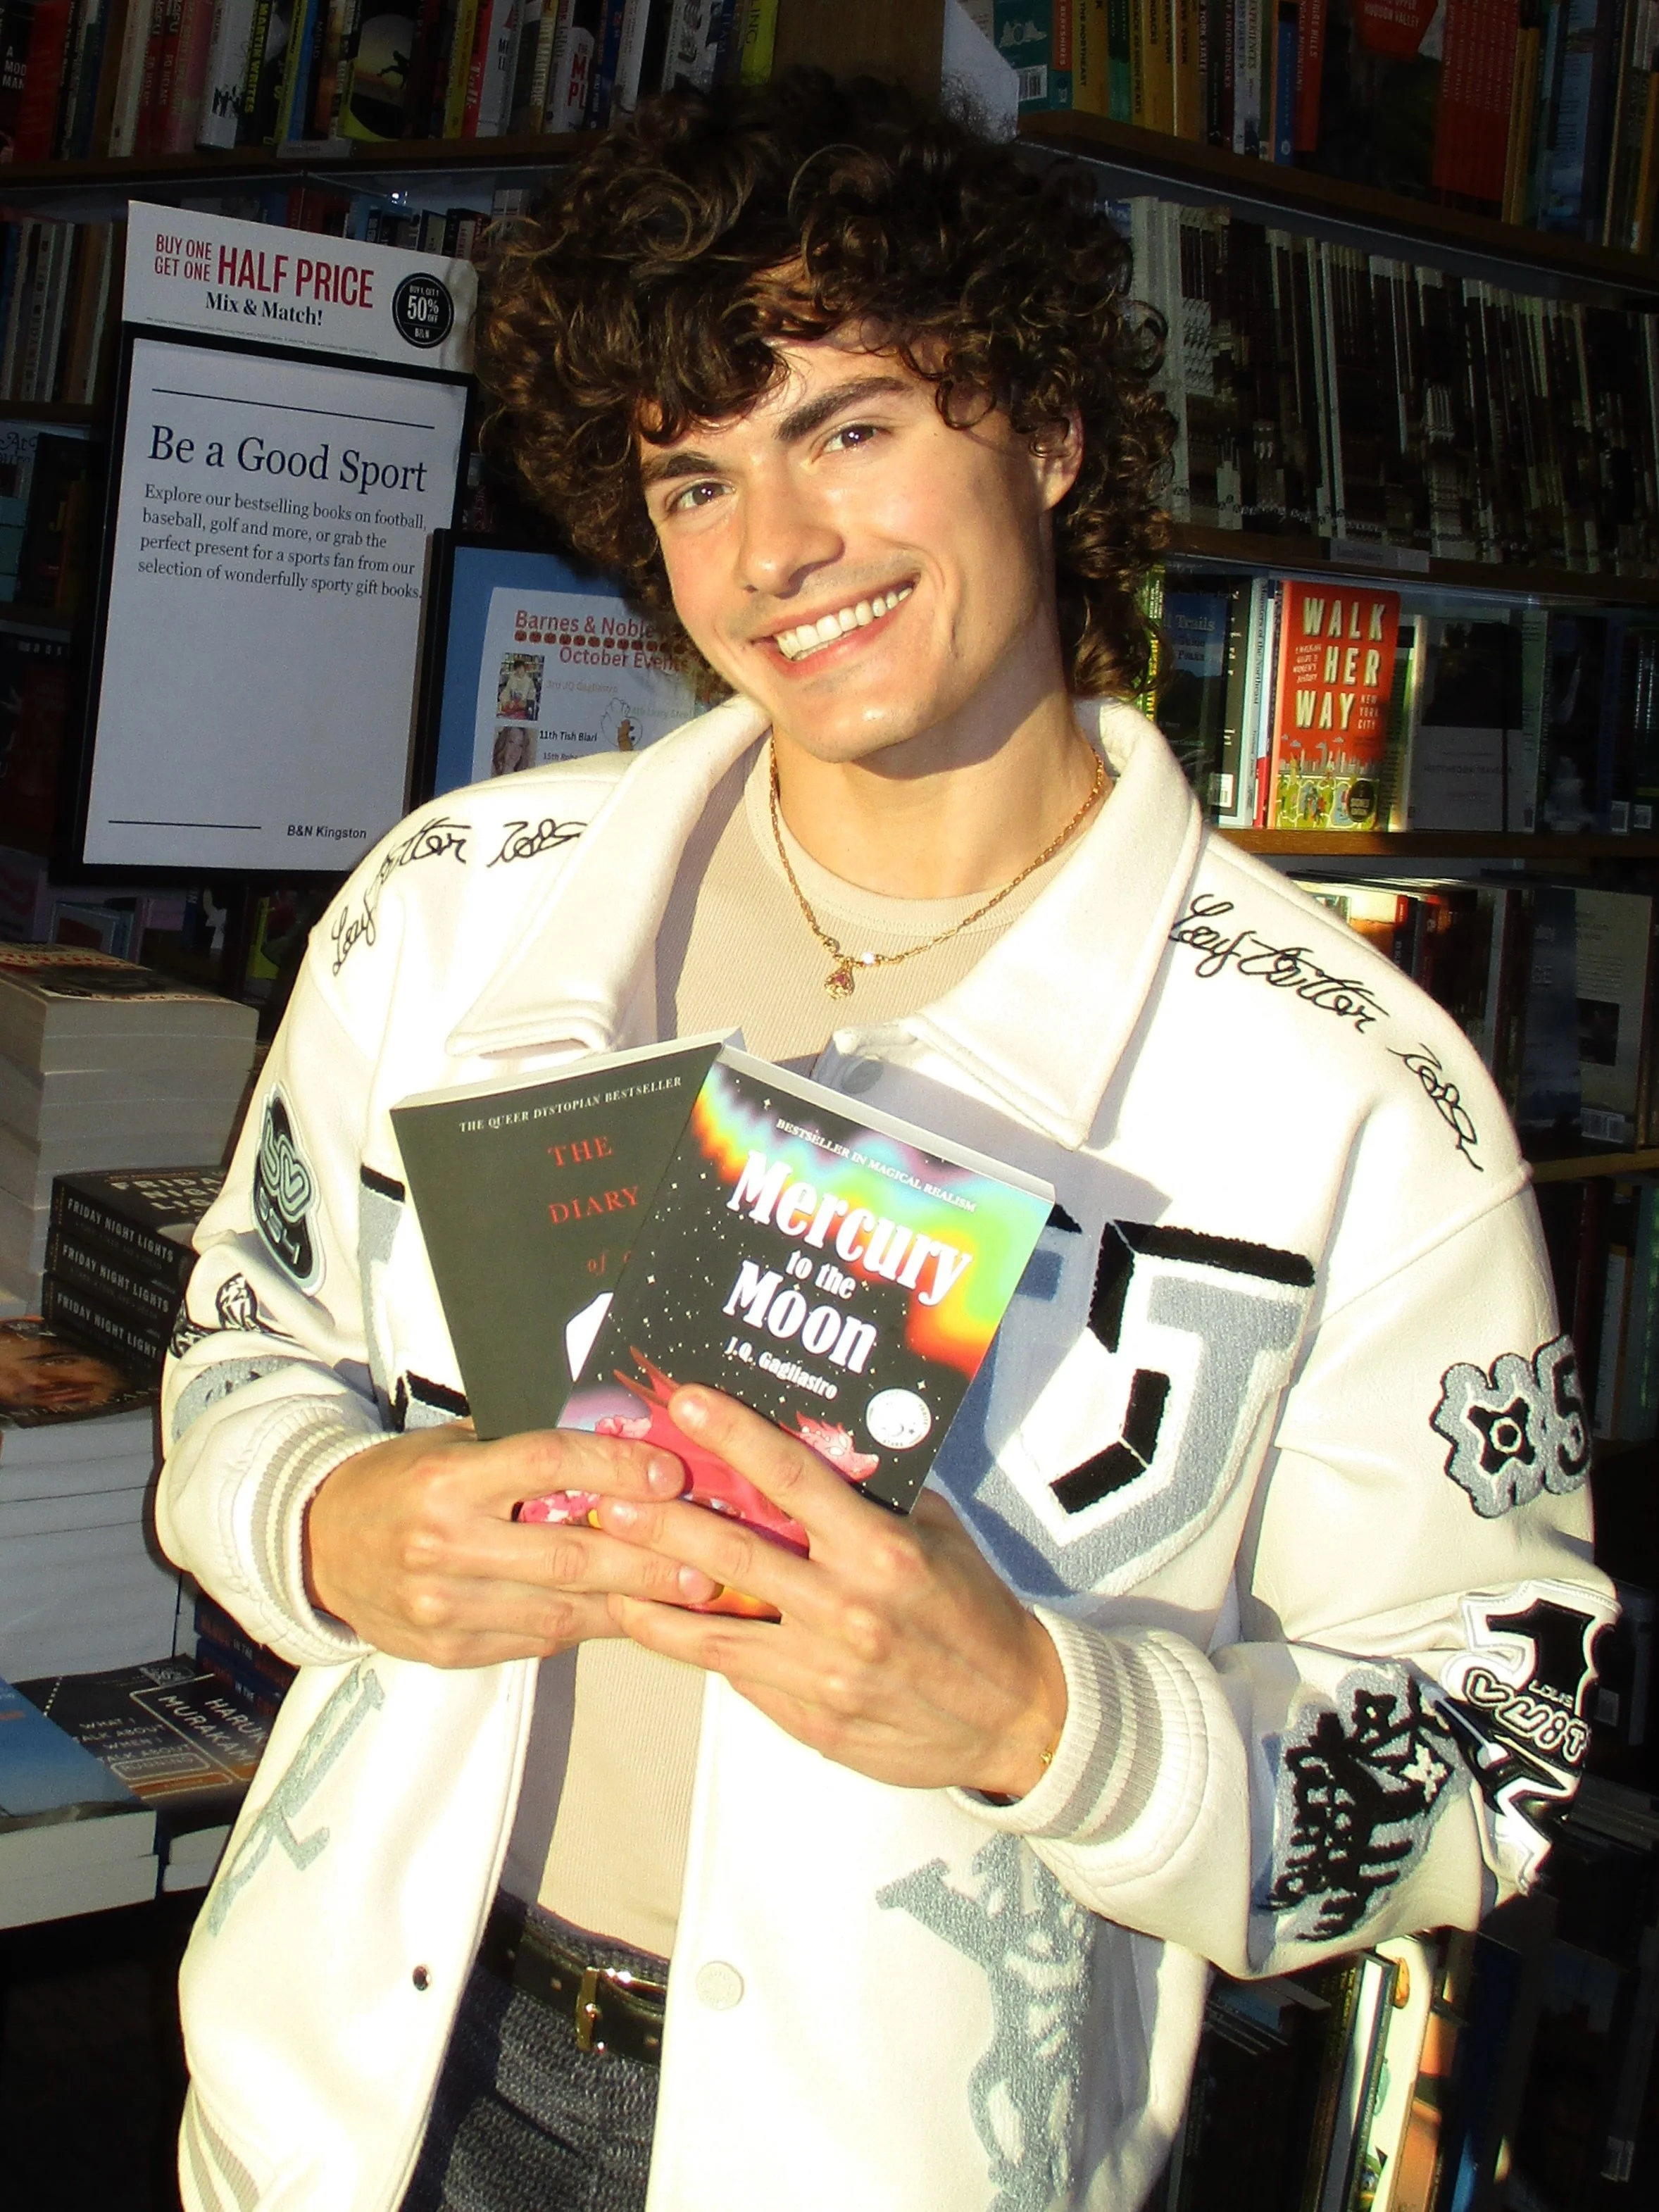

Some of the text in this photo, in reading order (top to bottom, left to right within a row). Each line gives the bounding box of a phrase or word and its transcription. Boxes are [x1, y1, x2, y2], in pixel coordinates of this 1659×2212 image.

[244, 1, 269, 116] MARTIN WRITES
[156, 234, 212, 261] BUY ONE
[154, 256, 211, 282] GET ONE
[218, 245, 374, 308] HALF PRICE
[206, 291, 323, 325] Mix & Match!
[407, 294, 439, 322] 50%
[148, 424, 428, 495] Be a Good Sport
[145, 484, 427, 531] Explore our bestselling books on football,
[142, 507, 387, 549] baseball, golf and more, or grab the
[140, 534, 415, 575] perfect present for a sports fan from our
[138, 559, 422, 599] selection of wonderfully sporty gift books.
[515, 610, 653, 638] Barnes & Noble
[1303, 596, 1386, 642] WALK
[560, 646, 628, 667] October
[1323, 646, 1381, 687] HER
[1253, 658, 1263, 704] Northeast
[1360, 694, 1377, 704] NEW
[1296, 689, 1355, 730] WAY
[1358, 719, 1375, 730] CITY
[1359, 706, 1378, 718] YORK
[539, 730, 557, 740] 11th
[560, 731, 576, 741] Tish
[287, 824, 367, 840] B&N Kingston
[459, 1076, 682, 1133] THE QUEER DYSTOPIAN BESTSELLER
[548, 1135, 613, 1168] THE
[776, 1118, 977, 1213] BESTSELLER IN MAGICAL REALISM
[111, 1177, 223, 1191] FRIDA
[141, 1187, 220, 1199] NIG
[150, 1199, 213, 1211] LIG
[549, 1185, 639, 1224] DIARY
[68, 1198, 102, 1225] FRIDAY
[105, 1216, 134, 1242] NIGHT
[137, 1233, 174, 1263] LIGHTS
[726, 1149, 972, 1307] Mercury
[62, 1244, 97, 1273] FRIDAY
[99, 1265, 130, 1290] NIGHT
[132, 1283, 170, 1313] LIGHTS
[587, 1251, 608, 1276] of
[785, 1249, 857, 1301] to the
[57, 1292, 92, 1321] FRIDAY
[94, 1313, 124, 1339] NIGHT
[722, 1260, 878, 1375] Moon
[725, 1336, 838, 1401] J.Q. Gagliastro
[79, 1718, 124, 1730] WHAT
[116, 1724, 166, 1738] ABOUT
[204, 1698, 267, 1744] HARUK
[103, 1737, 153, 1750] WHEN
[141, 1743, 190, 1758] ABOUT
